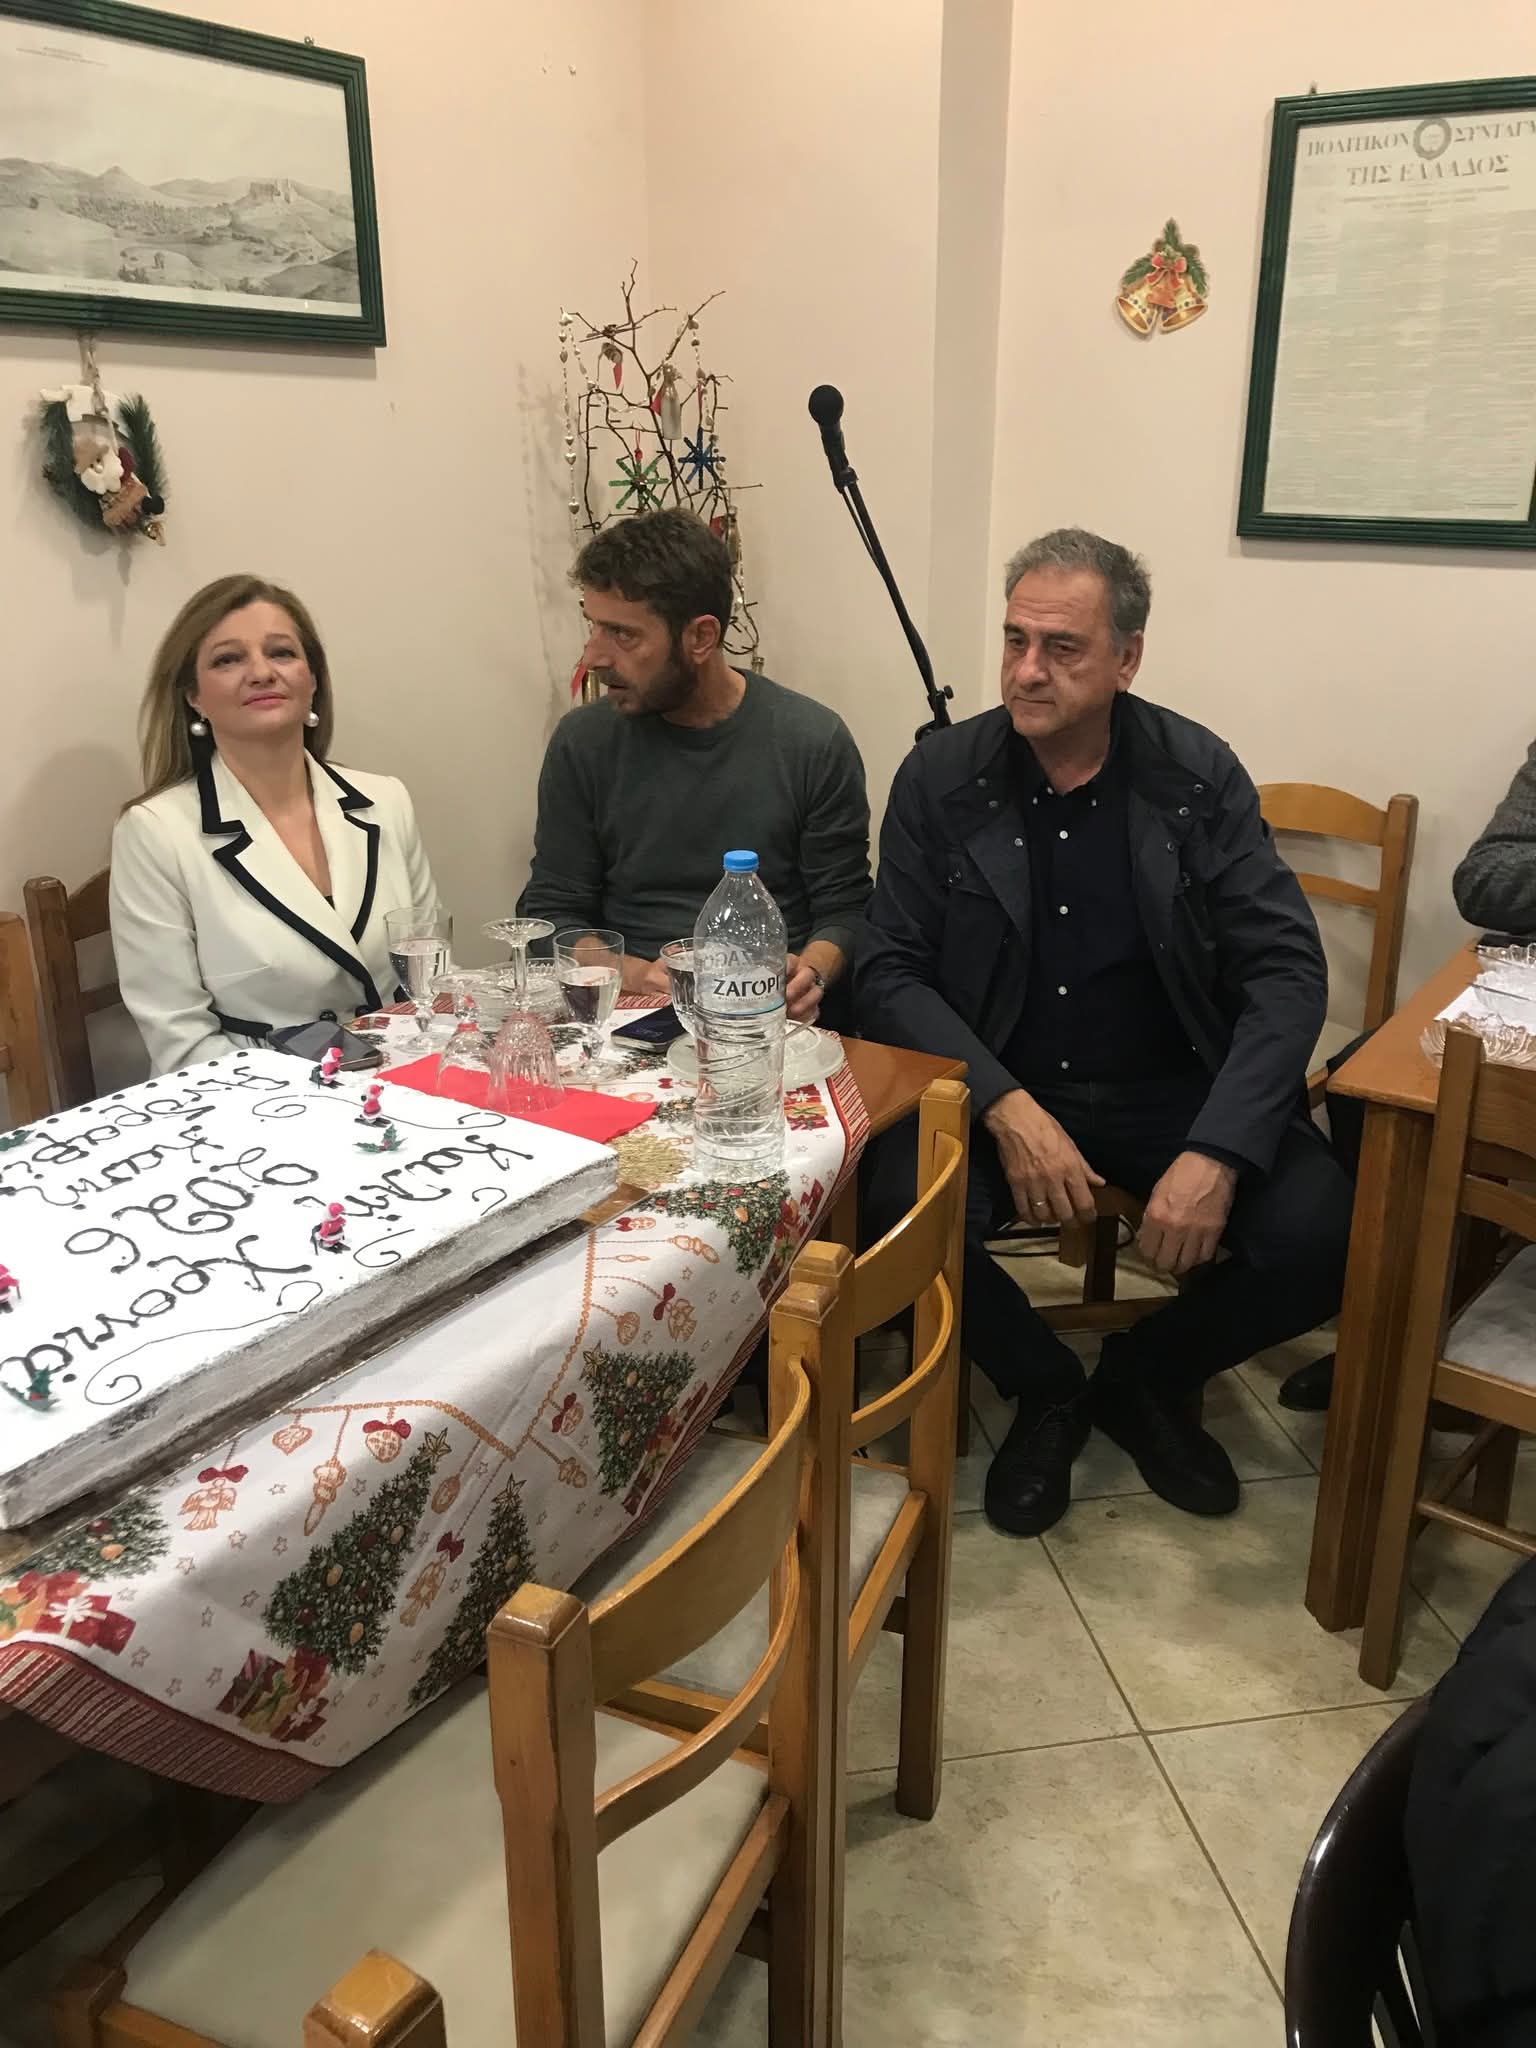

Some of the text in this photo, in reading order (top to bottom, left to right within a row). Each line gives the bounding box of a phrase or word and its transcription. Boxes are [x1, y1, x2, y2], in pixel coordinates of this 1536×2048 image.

[1347, 164, 1392, 185] ΤΗΣ
[1399, 154, 1510, 182] ΕΛΛΑΔΟΣ
[64, 1146, 319, 1274] 2026
